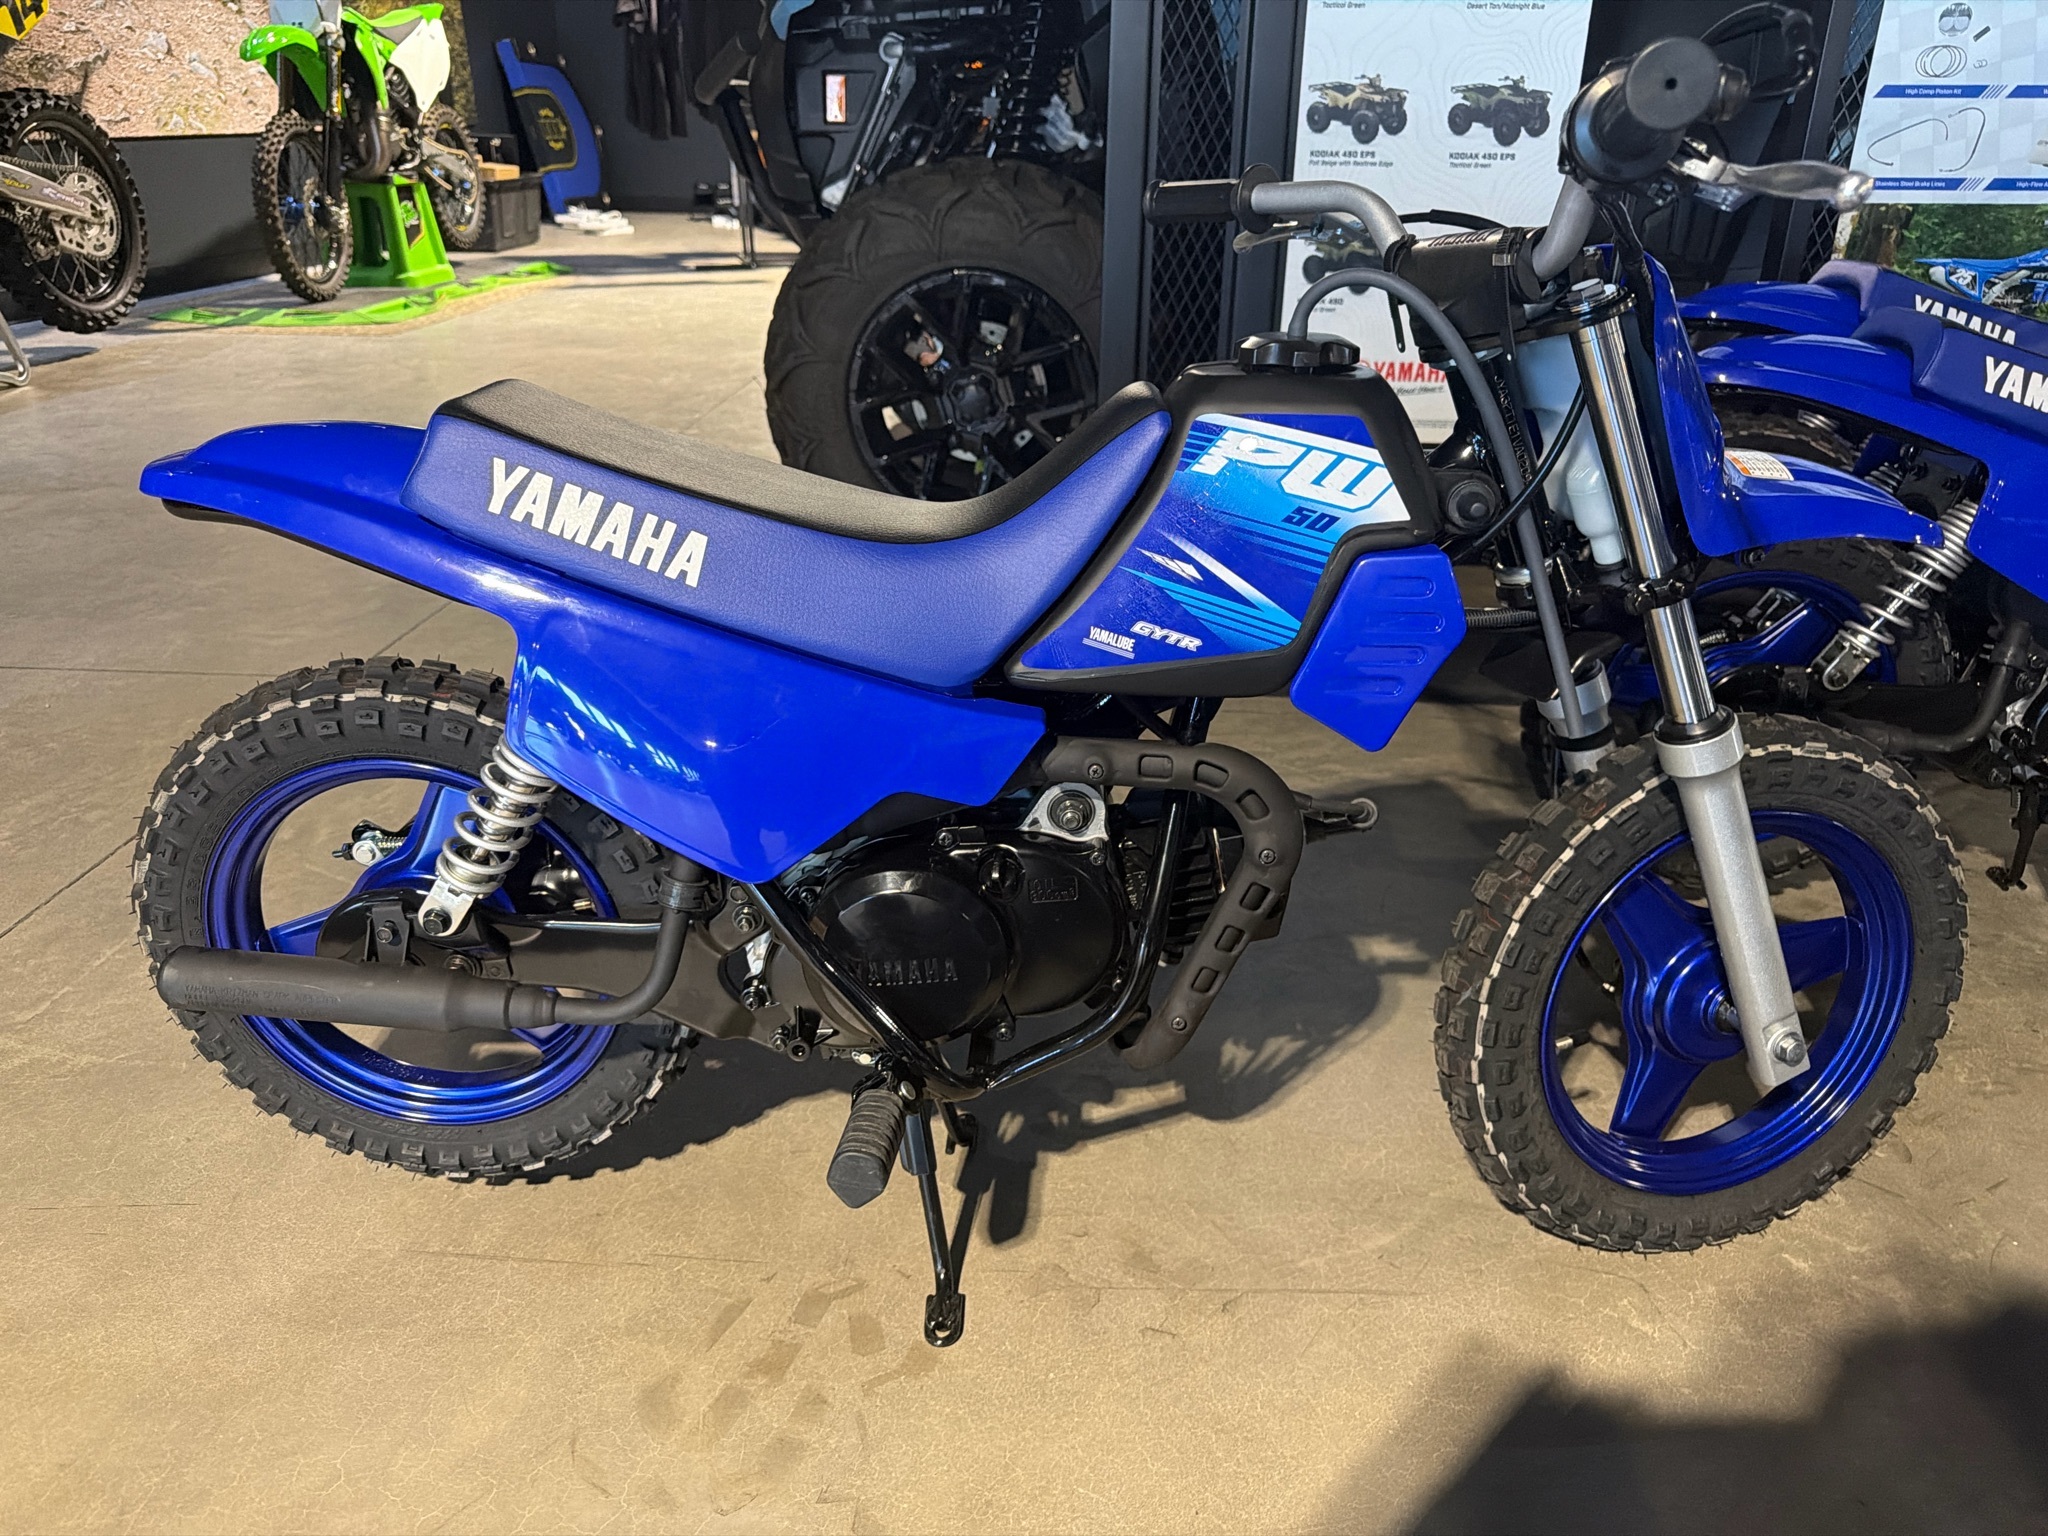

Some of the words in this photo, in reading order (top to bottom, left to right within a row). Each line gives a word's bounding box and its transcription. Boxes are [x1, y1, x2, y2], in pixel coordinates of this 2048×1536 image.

[1309, 150, 1340, 159] KODIAK
[1360, 150, 1376, 159] EPS
[1448, 152, 1479, 160] KODIAK
[1499, 153, 1516, 161] EPS
[1373, 361, 1447, 383] YAMAH
[1190, 429, 1394, 510] PW
[488, 457, 708, 588] YAMAHA
[1281, 505, 1341, 533] 50
[1089, 626, 1136, 652] YAMALUBE
[1130, 620, 1203, 652] GYTR
